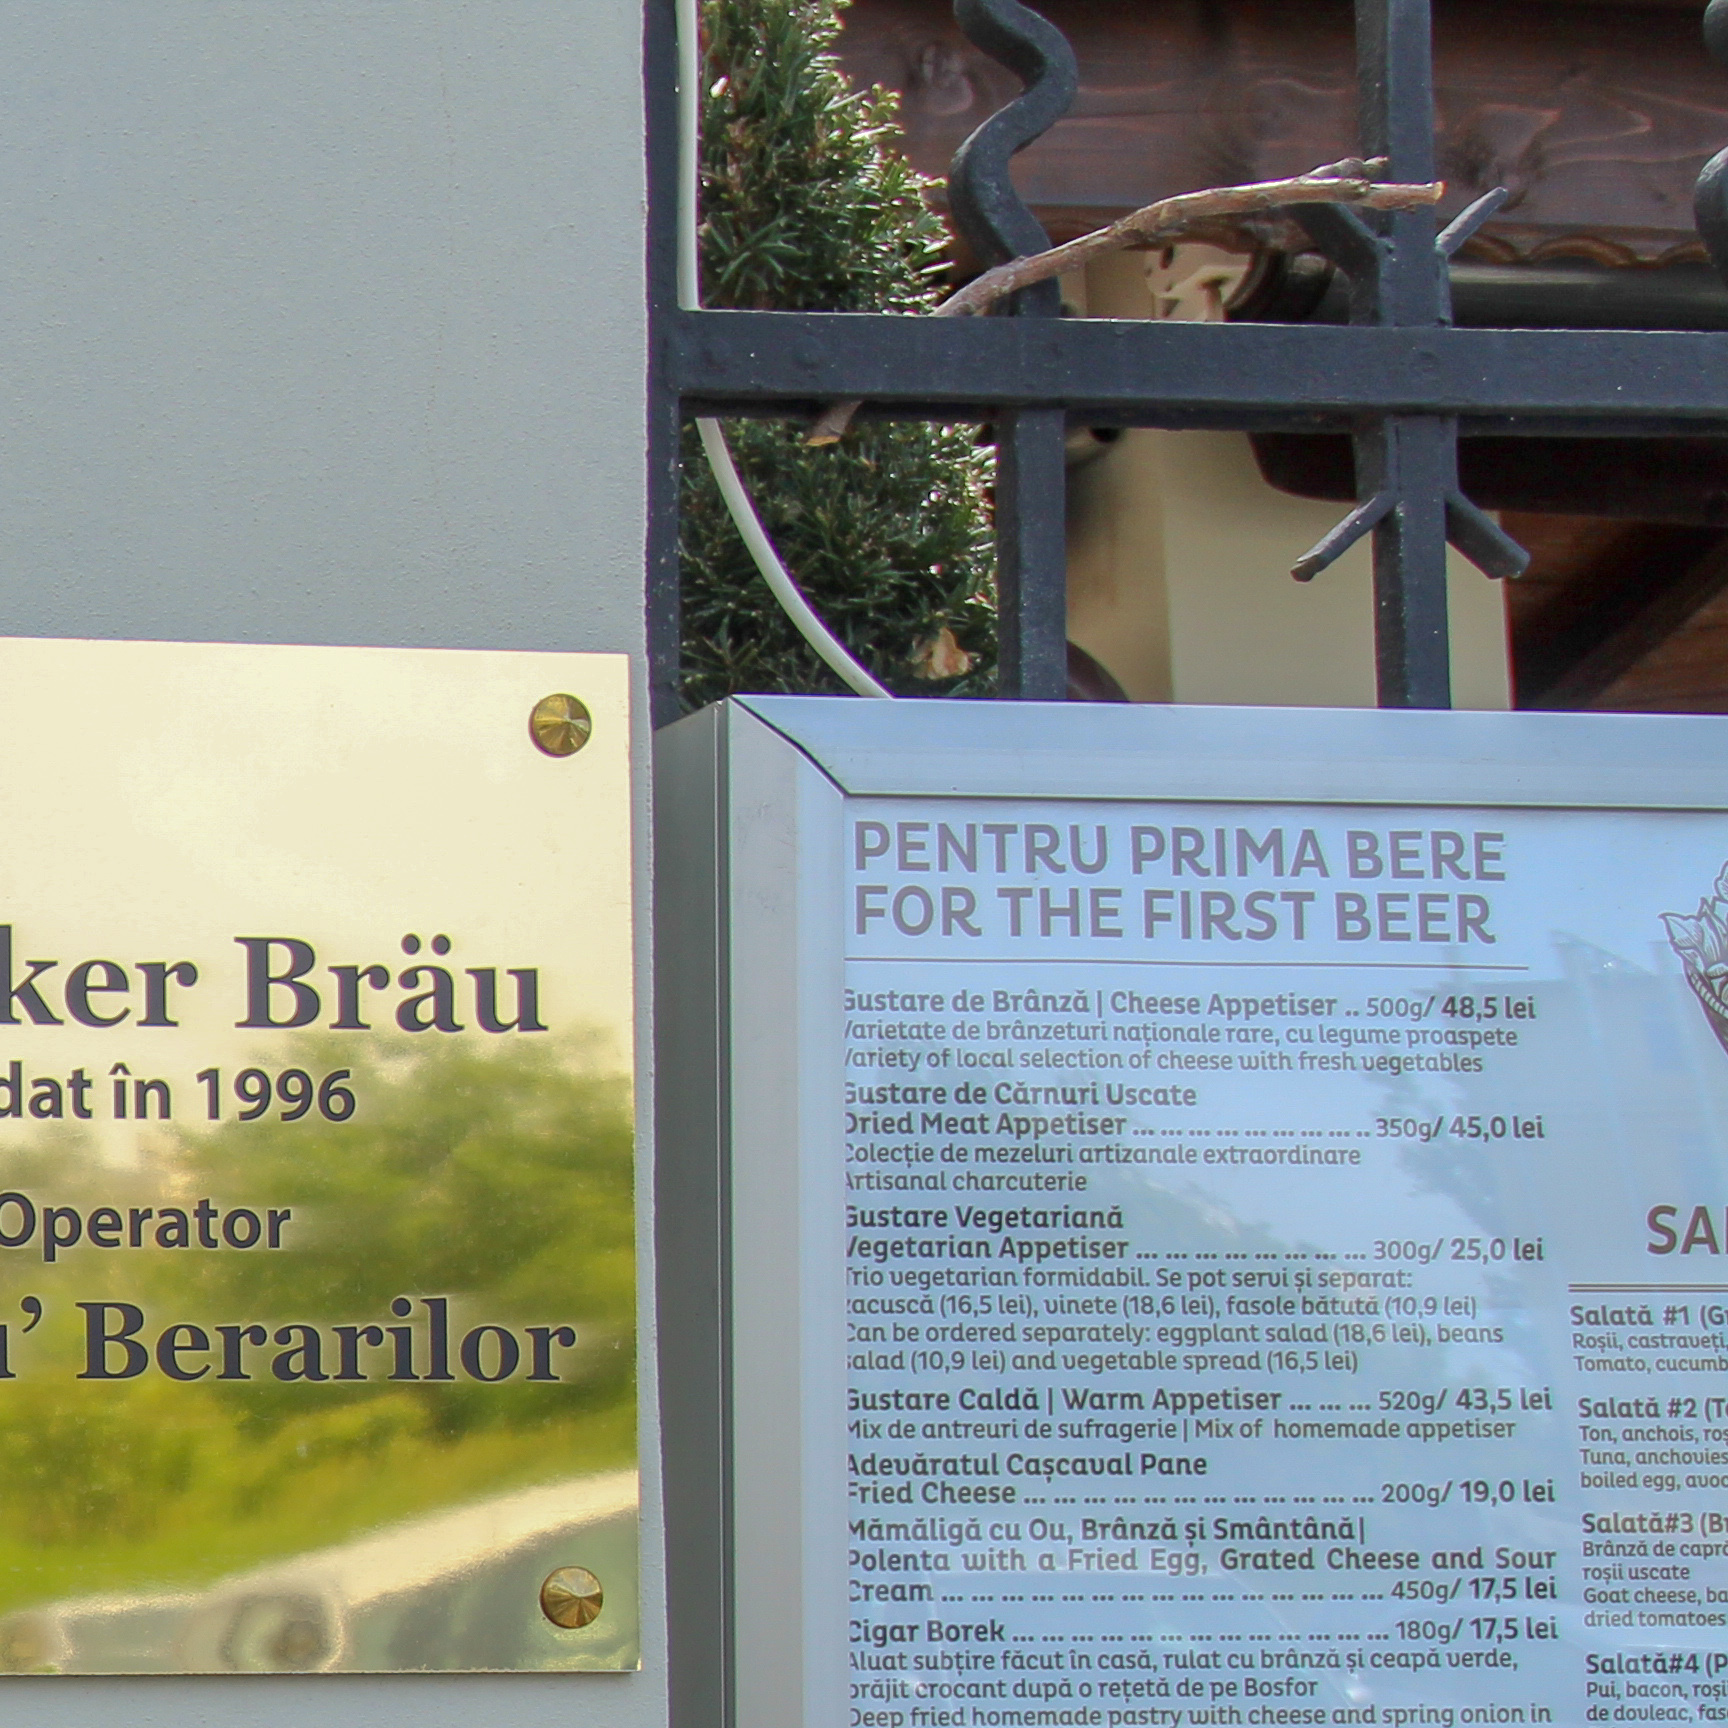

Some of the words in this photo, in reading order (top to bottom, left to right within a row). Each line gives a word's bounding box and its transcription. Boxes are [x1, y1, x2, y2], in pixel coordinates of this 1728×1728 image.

[856, 822, 1107, 874] PENTRU
[1131, 826, 1330, 878] PRIMA
[1347, 831, 1506, 881] BERE
[856, 886, 982, 937] FOR
[997, 888, 1123, 937] THE
[1144, 890, 1315, 940] FIRST
[1335, 893, 1496, 944] BEER
[234, 933, 548, 1033] Bräu
[951, 988, 985, 1013] de
[1110, 990, 1201, 1016] Cheese
[1206, 993, 1338, 1021] Appetiser
[1440, 995, 1498, 1024] 48,5
[1504, 995, 1537, 1020] lei
[112, 1064, 172, 1120] în
[196, 1068, 357, 1122] 1996
[920, 1112, 991, 1135] Meat
[995, 1112, 1128, 1141] Appetiser
[1448, 1115, 1507, 1144] 45,0
[1512, 1115, 1546, 1139] lei
[76, 1297, 576, 1383] Berarilor
[1061, 1387, 1146, 1411] Warm
[1151, 1387, 1283, 1416] Appetiser
[1455, 1387, 1513, 1416] 43,5
[1520, 1387, 1554, 1411] lei
[1140, 1452, 1208, 1476] Pane
